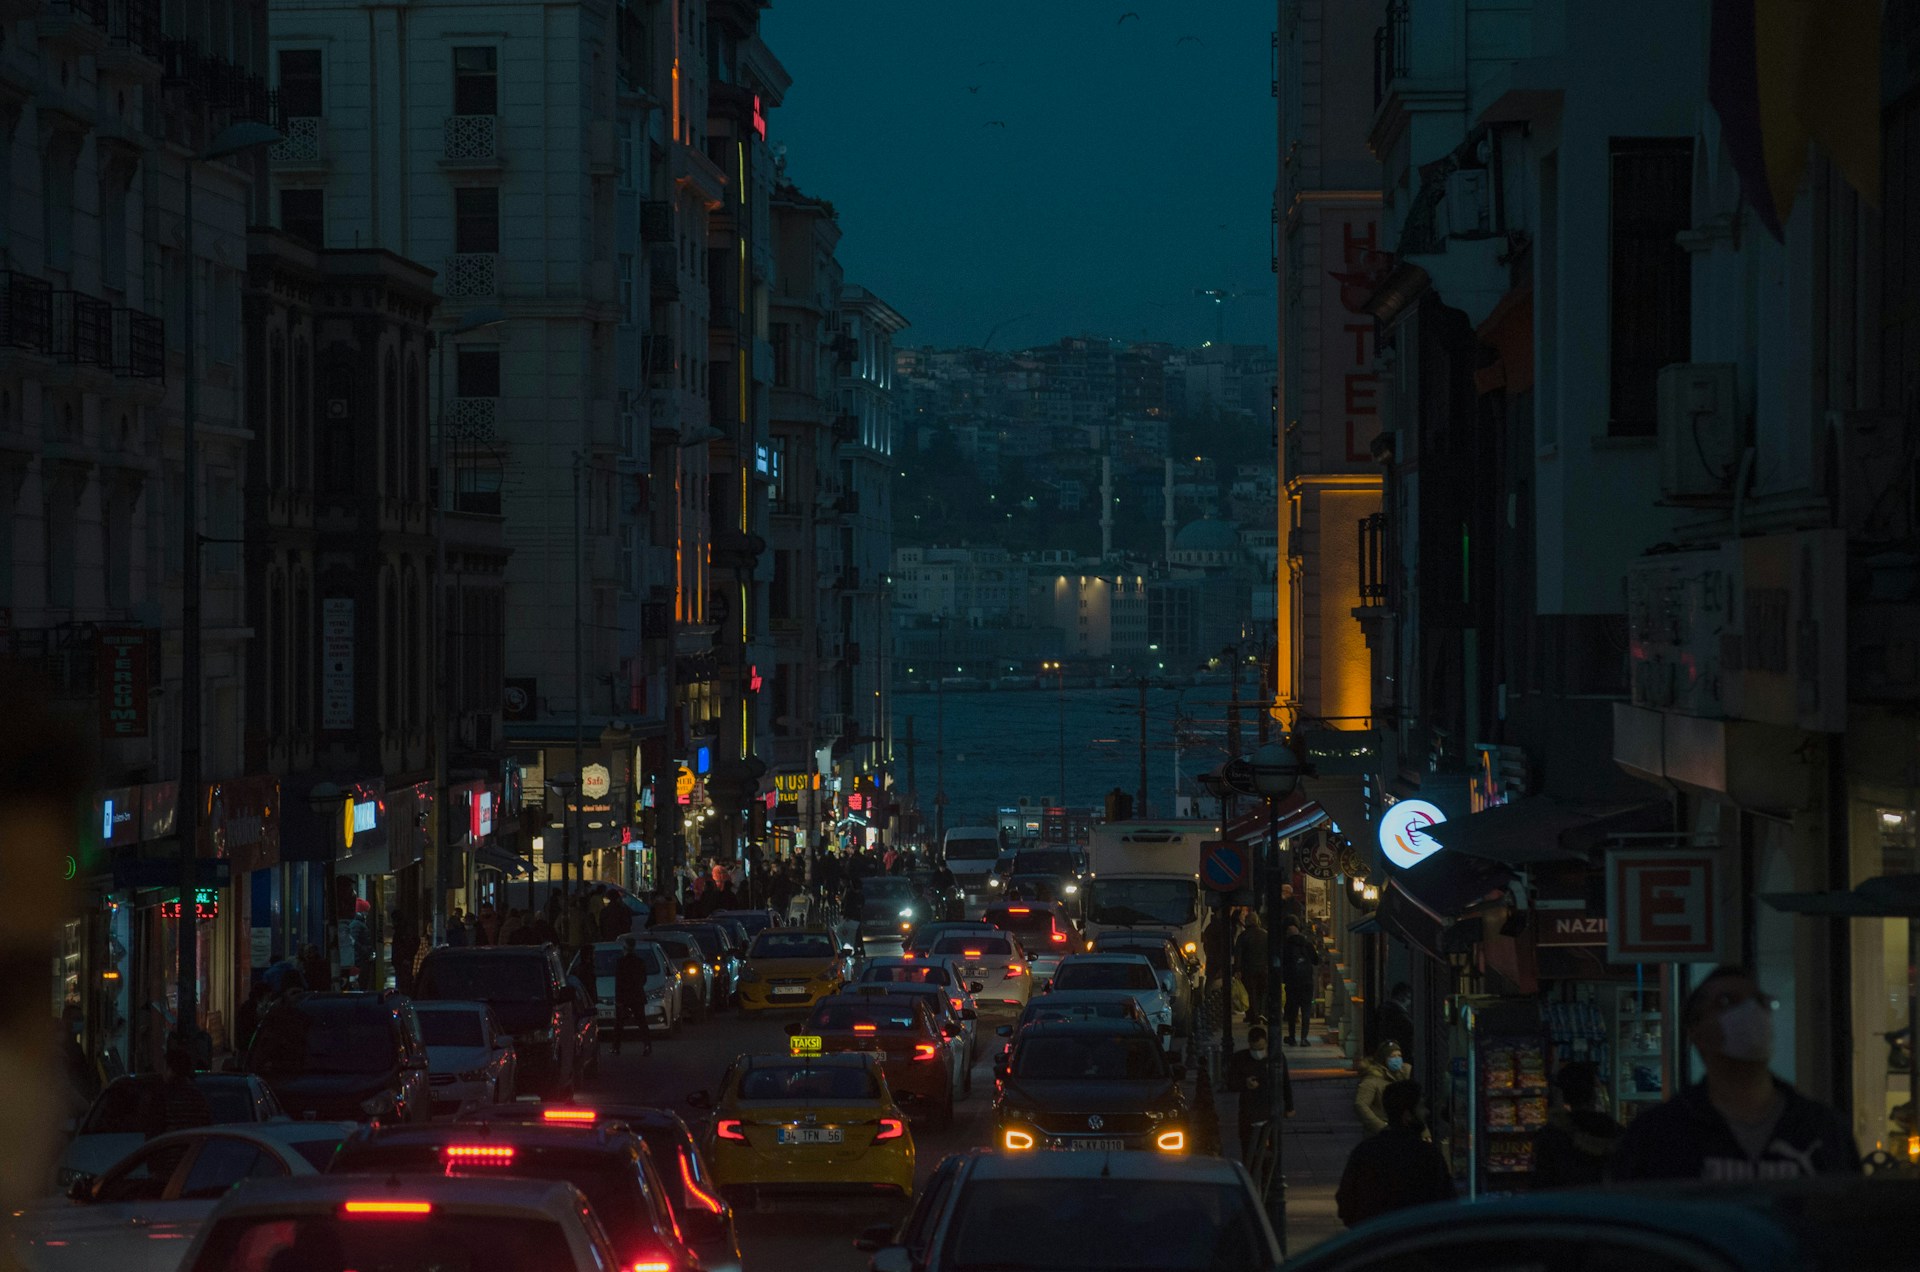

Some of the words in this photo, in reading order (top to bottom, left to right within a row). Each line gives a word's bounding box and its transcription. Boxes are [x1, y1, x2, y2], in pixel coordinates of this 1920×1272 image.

[110, 646, 136, 732] TERCÜME
[587, 777, 604, 785] Safa
[1556, 918, 1608, 934] NAZI
[785, 1131, 796, 1141] 34
[803, 1130, 819, 1140] TFN
[828, 1130, 840, 1141] 56
